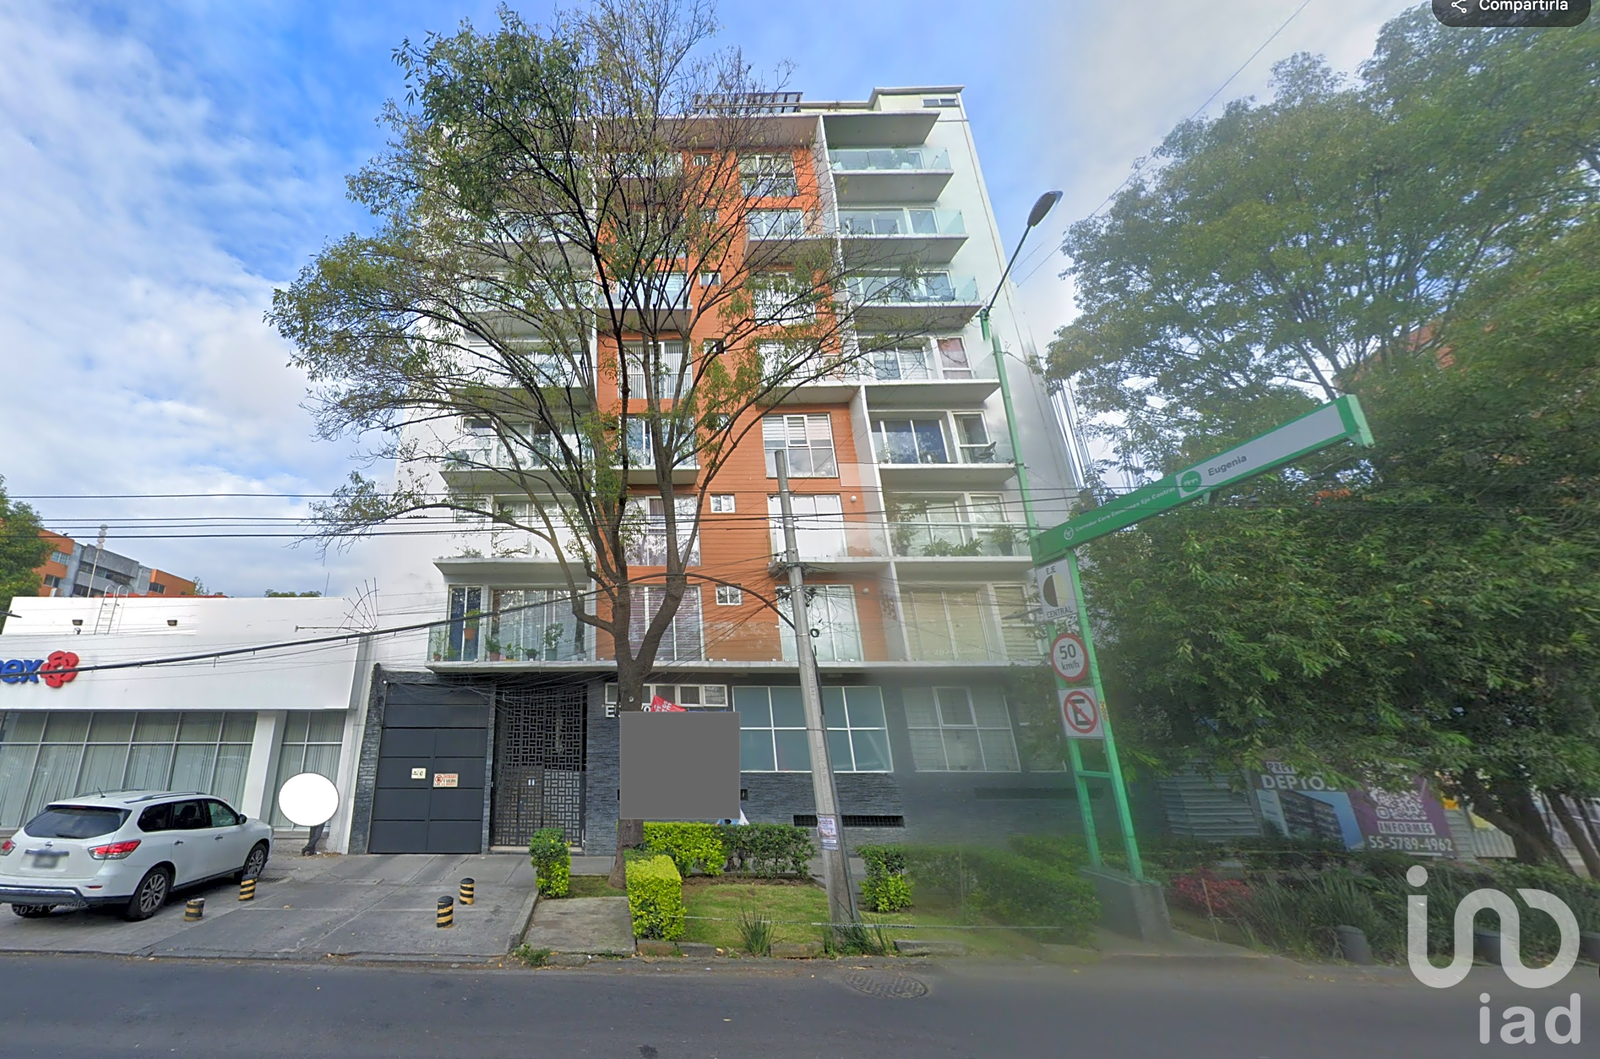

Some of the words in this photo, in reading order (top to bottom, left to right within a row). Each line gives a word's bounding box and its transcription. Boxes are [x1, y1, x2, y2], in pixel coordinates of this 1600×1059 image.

[1207, 455, 1248, 477] Eugenia
[1046, 606, 1073, 619] CENTRAL
[1059, 643, 1077, 660] 50
[0, 659, 44, 684] ex
[1061, 661, 1080, 671] km/h
[1261, 774, 1337, 791] DEPTO
[1379, 822, 1433, 833] INFORMES
[1368, 835, 1454, 852] 55-5789-4962
